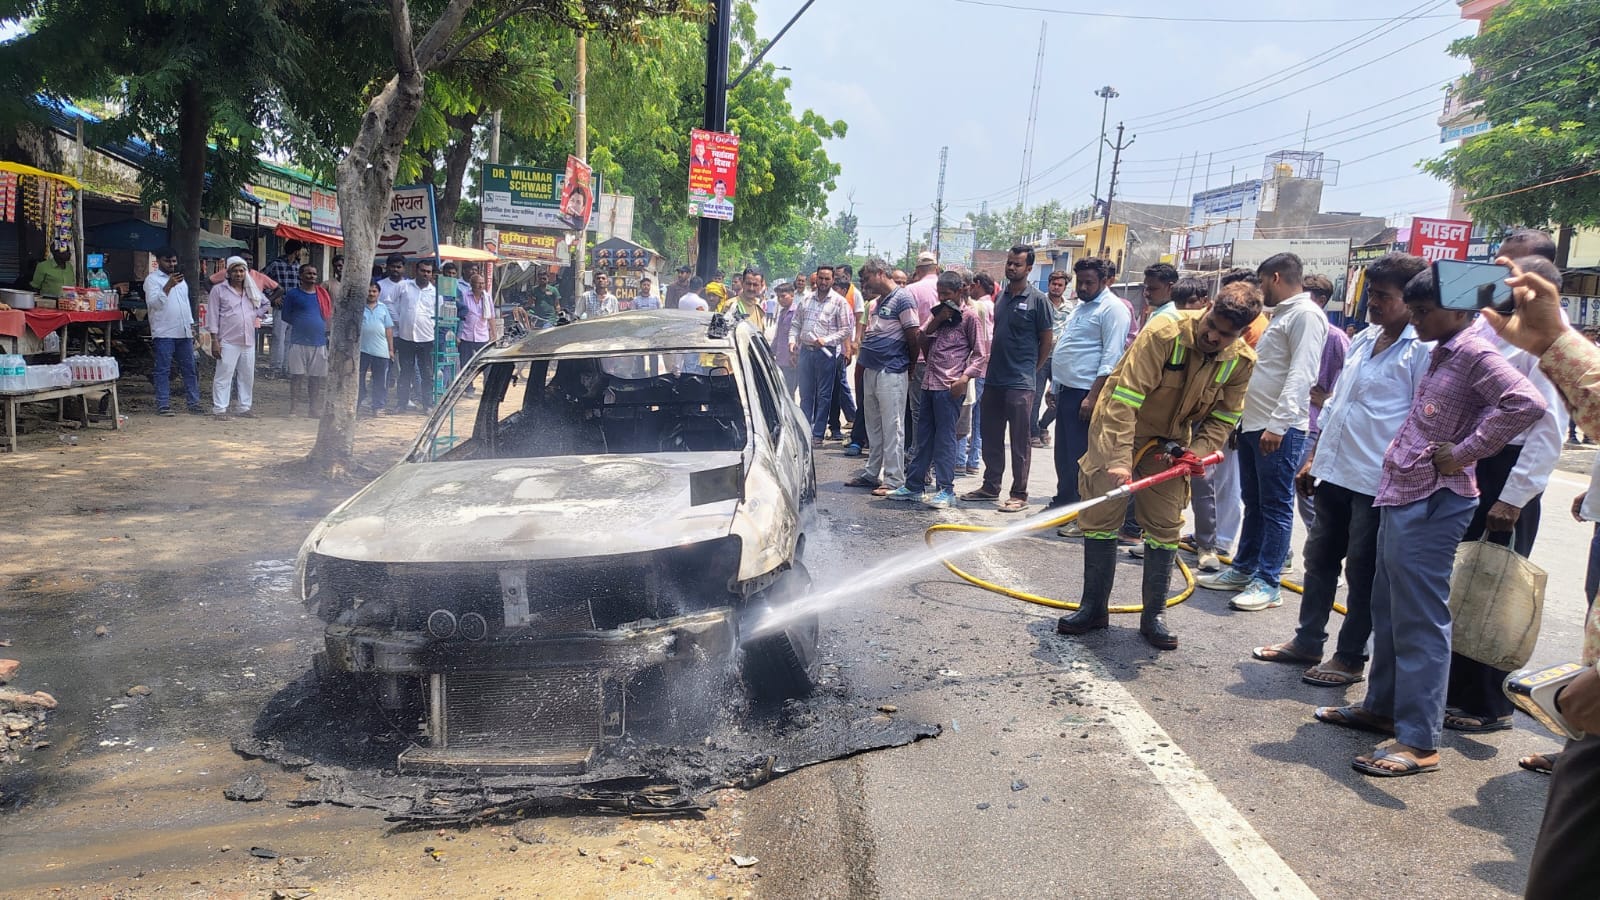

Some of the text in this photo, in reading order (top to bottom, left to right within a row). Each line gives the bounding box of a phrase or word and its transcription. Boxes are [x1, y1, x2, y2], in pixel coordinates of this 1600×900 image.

[492, 168, 553, 183] DR. WILLMAR
[509, 181, 553, 193] SCHWABE
[389, 213, 428, 231] सेन्टर
[500, 232, 528, 245] सुमित
[615, 288, 637, 299] CHAI
